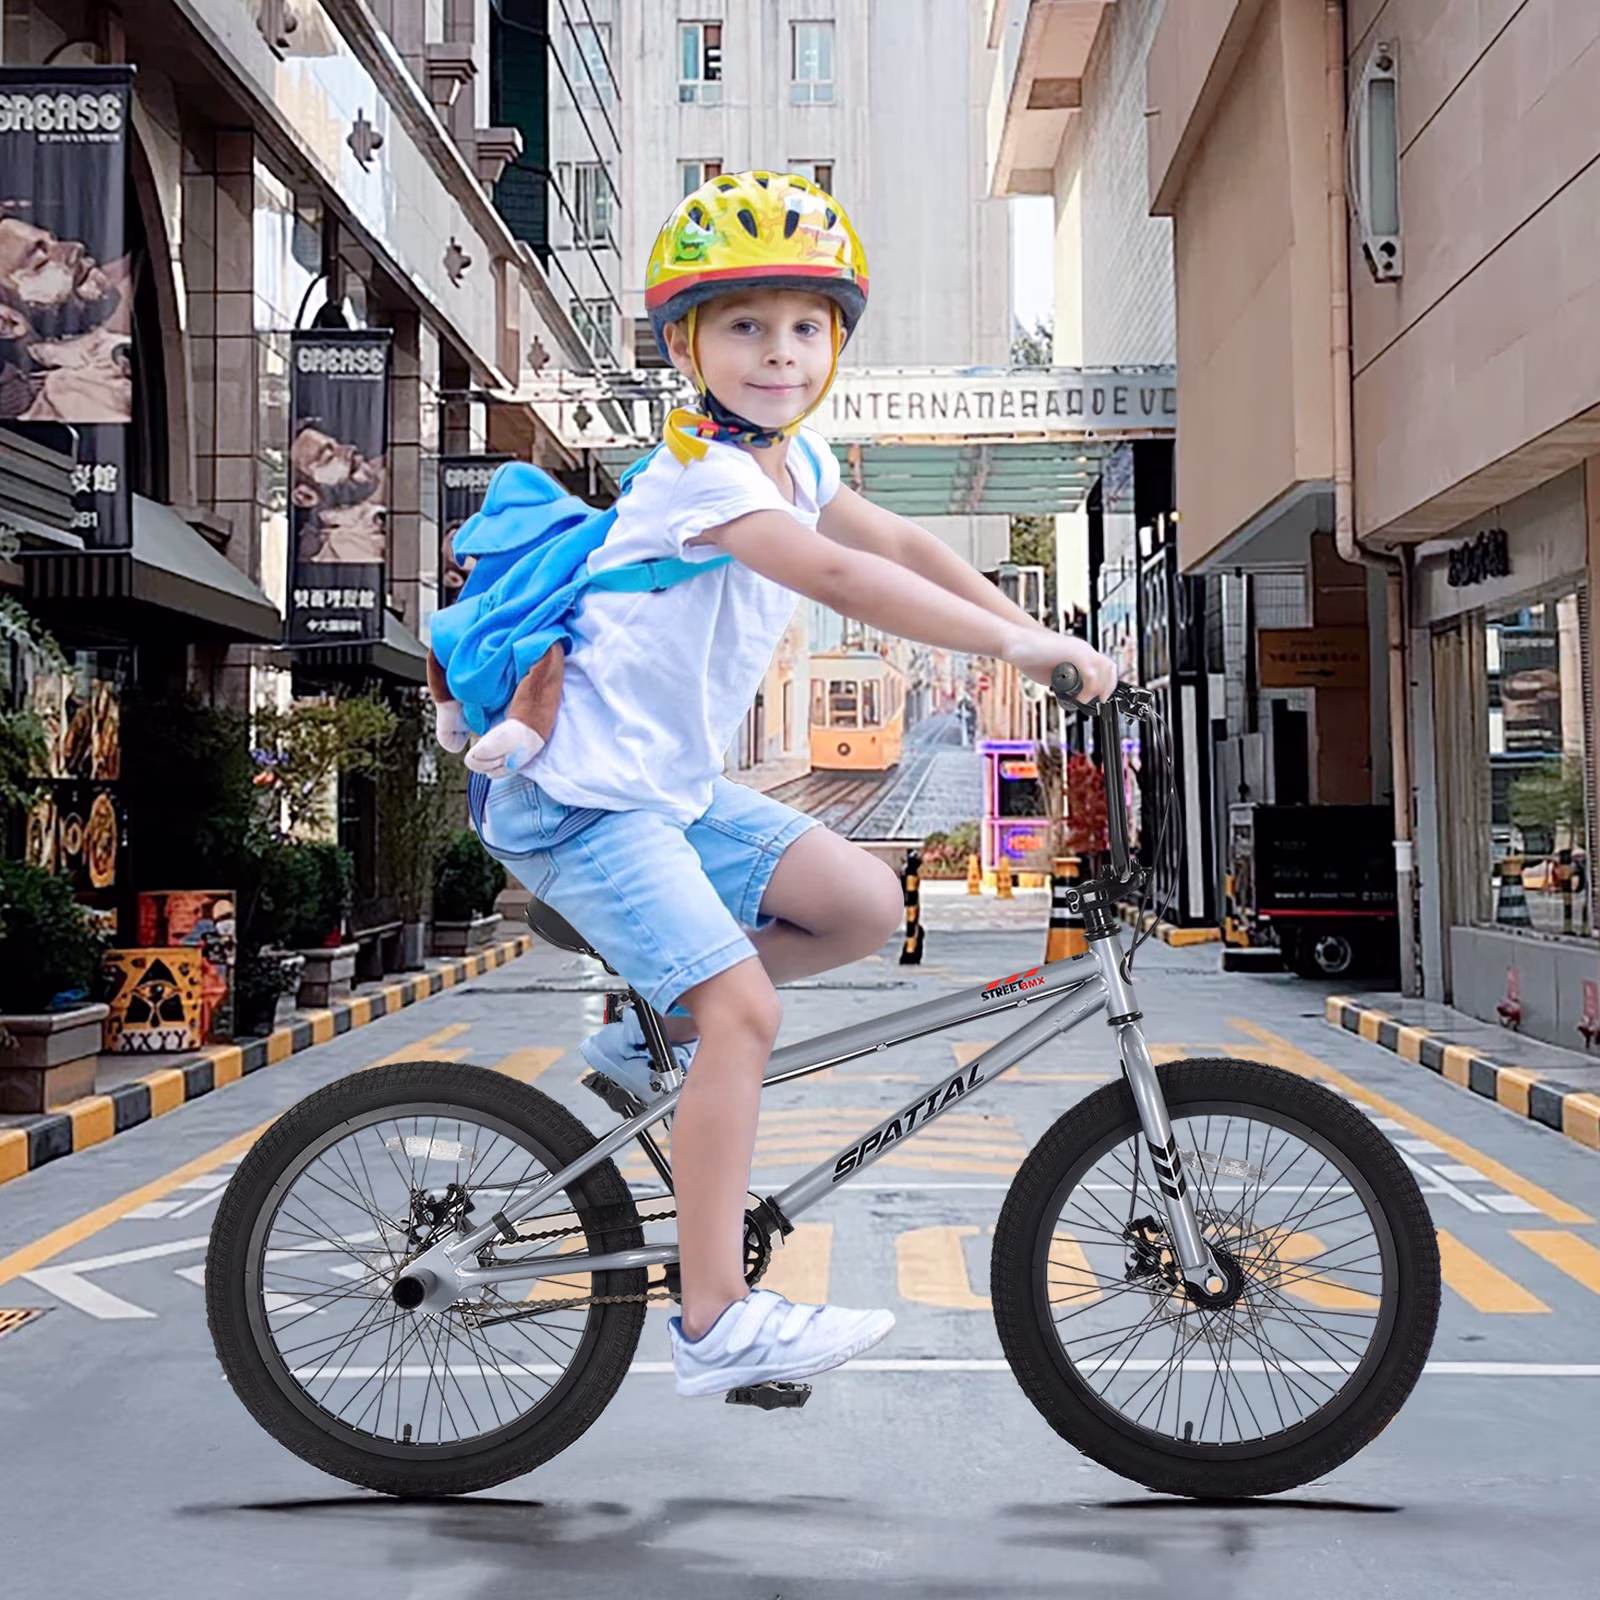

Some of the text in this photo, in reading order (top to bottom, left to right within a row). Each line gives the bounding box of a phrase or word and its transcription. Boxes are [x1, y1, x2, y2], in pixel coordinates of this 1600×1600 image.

[981, 976, 1045, 1002] STREET BMX
[832, 1063, 985, 1183] SPATIAL
